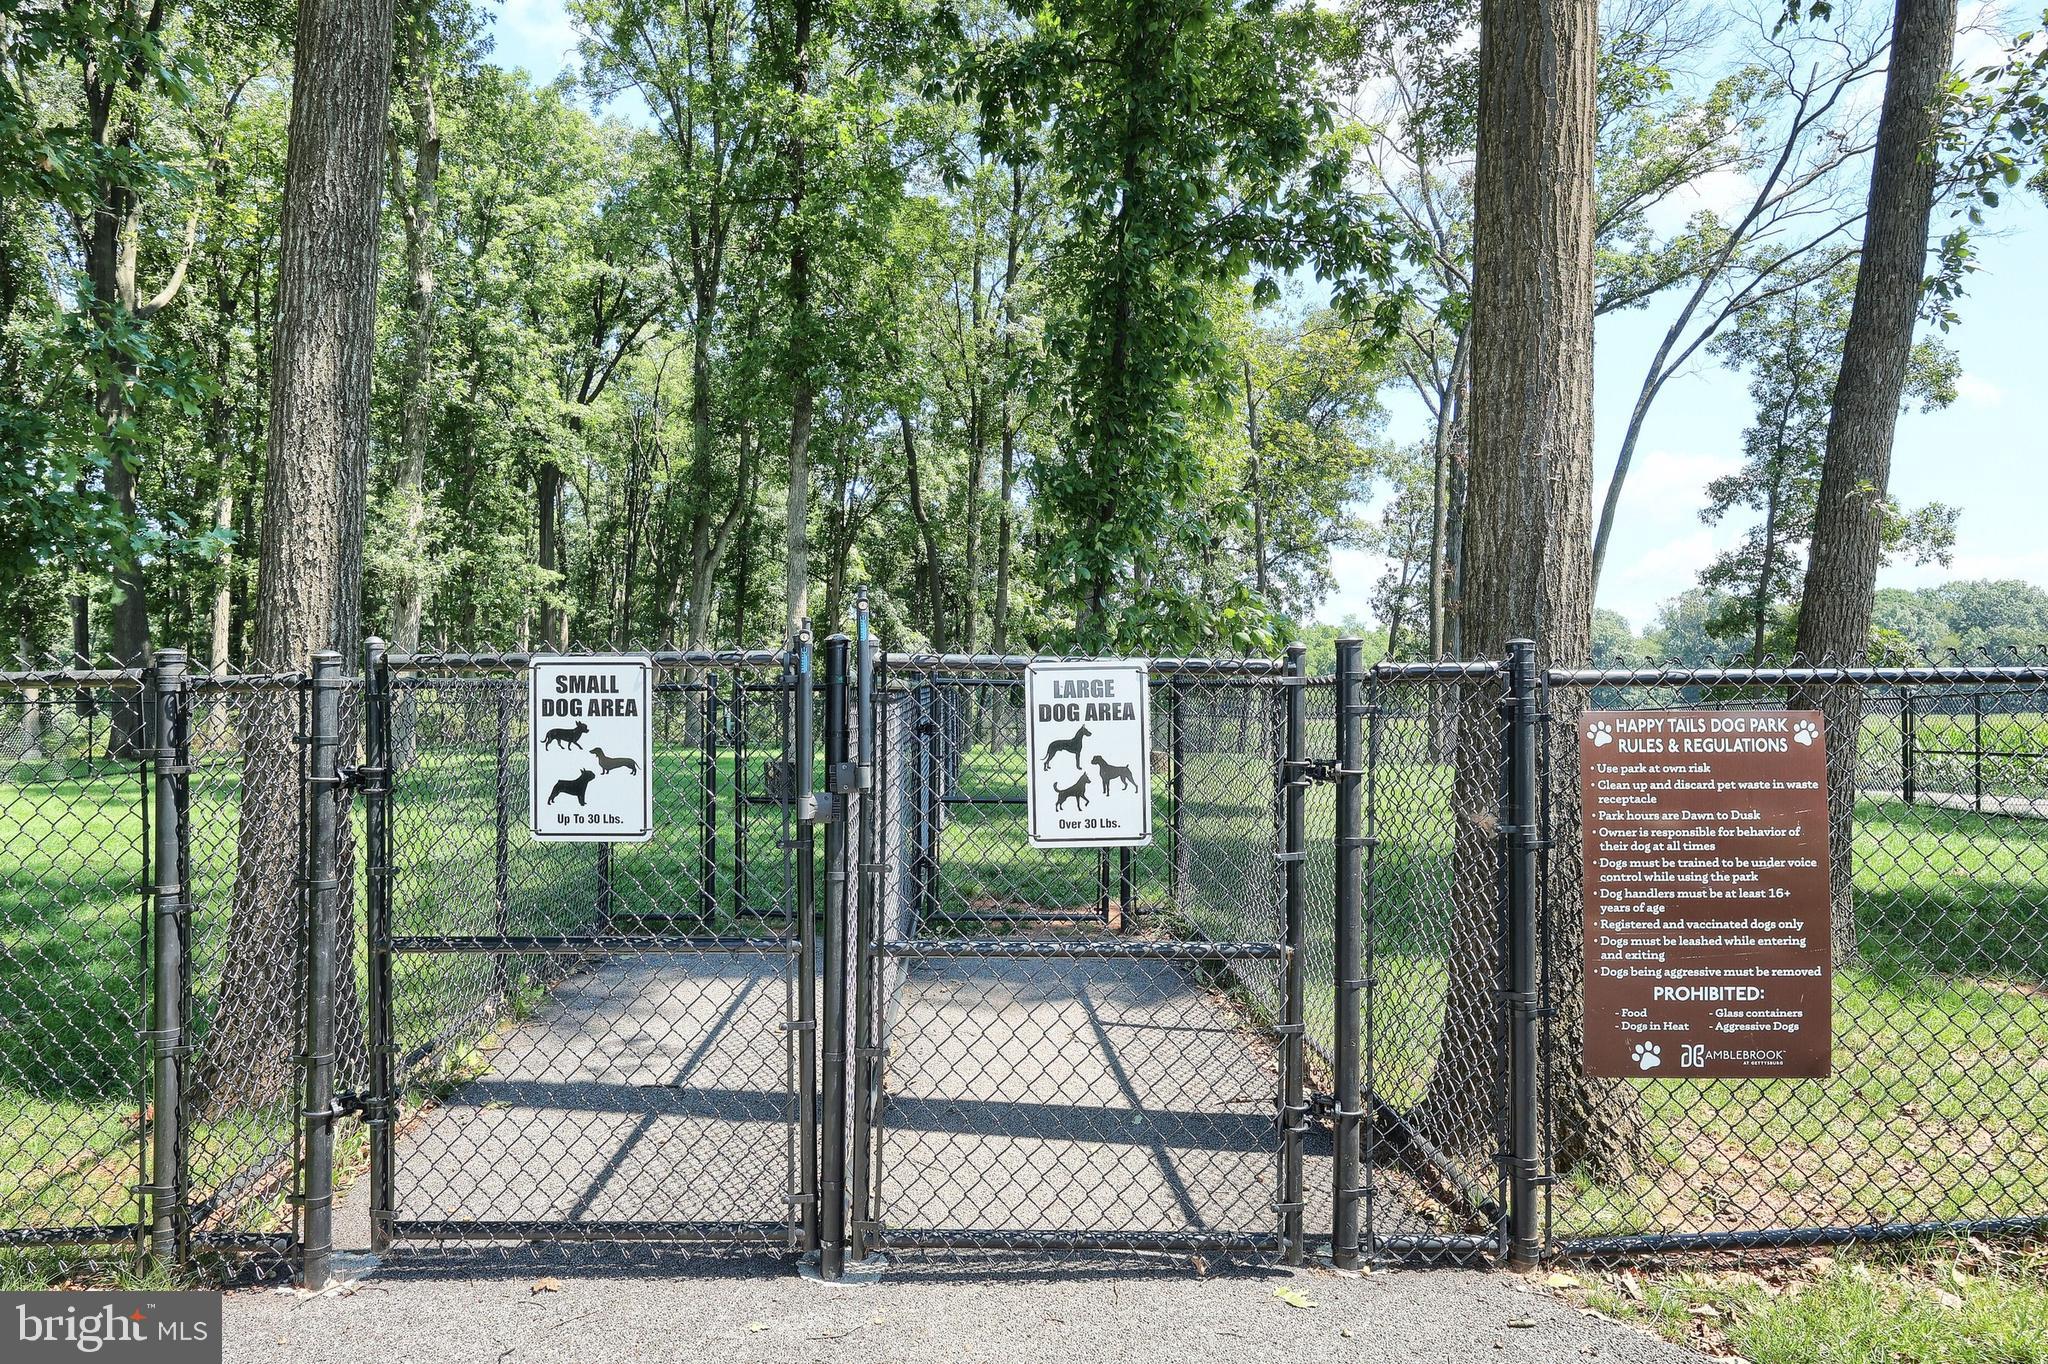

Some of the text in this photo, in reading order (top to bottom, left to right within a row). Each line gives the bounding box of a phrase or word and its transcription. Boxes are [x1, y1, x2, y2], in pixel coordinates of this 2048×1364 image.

[556, 675, 619, 694] SMALL
[1053, 679, 1115, 699] LARGE
[541, 698, 638, 717] DOG AREA
[1038, 702, 1136, 722] DOG AREA
[1616, 717, 1789, 734] HAPPY TAILS DOG PARK
[1619, 738, 1788, 753] RULES & REGULATIONS
[1597, 764, 1618, 774] Use
[1621, 763, 1647, 775] park
[1649, 765, 1660, 773] at
[1689, 763, 1710, 773] risk
[1598, 779, 1818, 792] Clean up and discard pet waste in waste
[1598, 793, 1657, 806] receptacle
[557, 813, 624, 826] Up To 30 Lbs.
[1599, 810, 1760, 822] Park hours are Dawn to Dusk
[1059, 818, 1121, 829] Over 30 Lbs.
[1599, 826, 1801, 839] Owner is responsible for behavior of
[1600, 841, 1628, 851] their
[1631, 841, 1651, 853] dog
[1667, 841, 1681, 850] all
[1683, 841, 1715, 850] times
[1598, 858, 1627, 870] Dogs
[1662, 858, 1675, 867] be
[1678, 857, 1720, 867] trained
[1722, 859, 1733, 867] to
[1735, 857, 1749, 867] be
[1751, 857, 1786, 869] under
[1787, 857, 1817, 867] voice
[1599, 871, 1758, 884] control while using the park
[1600, 887, 1790, 901] Dog handlers must be at least 16+
[1600, 902, 1665, 915] years of age
[1601, 919, 1804, 931] Registered and vaccinated dogs only
[1601, 936, 1628, 948] Dogs
[1663, 936, 1676, 945] be
[1679, 936, 1722, 945] leashed
[1724, 936, 1755, 945] while
[1758, 936, 1806, 948] entering
[1599, 950, 1665, 962] and exiting
[1601, 967, 1628, 979] Dogs
[1630, 966, 1662, 979] being
[1664, 967, 1721, 979] aggressive
[1756, 966, 1769, 976] be
[1772, 966, 1821, 976] removed
[1654, 987, 1764, 1001] PROHIBITED:
[1622, 1008, 1647, 1017] Food
[1716, 1008, 1802, 1017] Glass containers
[1622, 1022, 1689, 1032] Dogs in Heat
[1715, 1022, 1799, 1033] Aggressive Dogs
[1705, 1051, 1784, 1059] AMBLEBROOK
